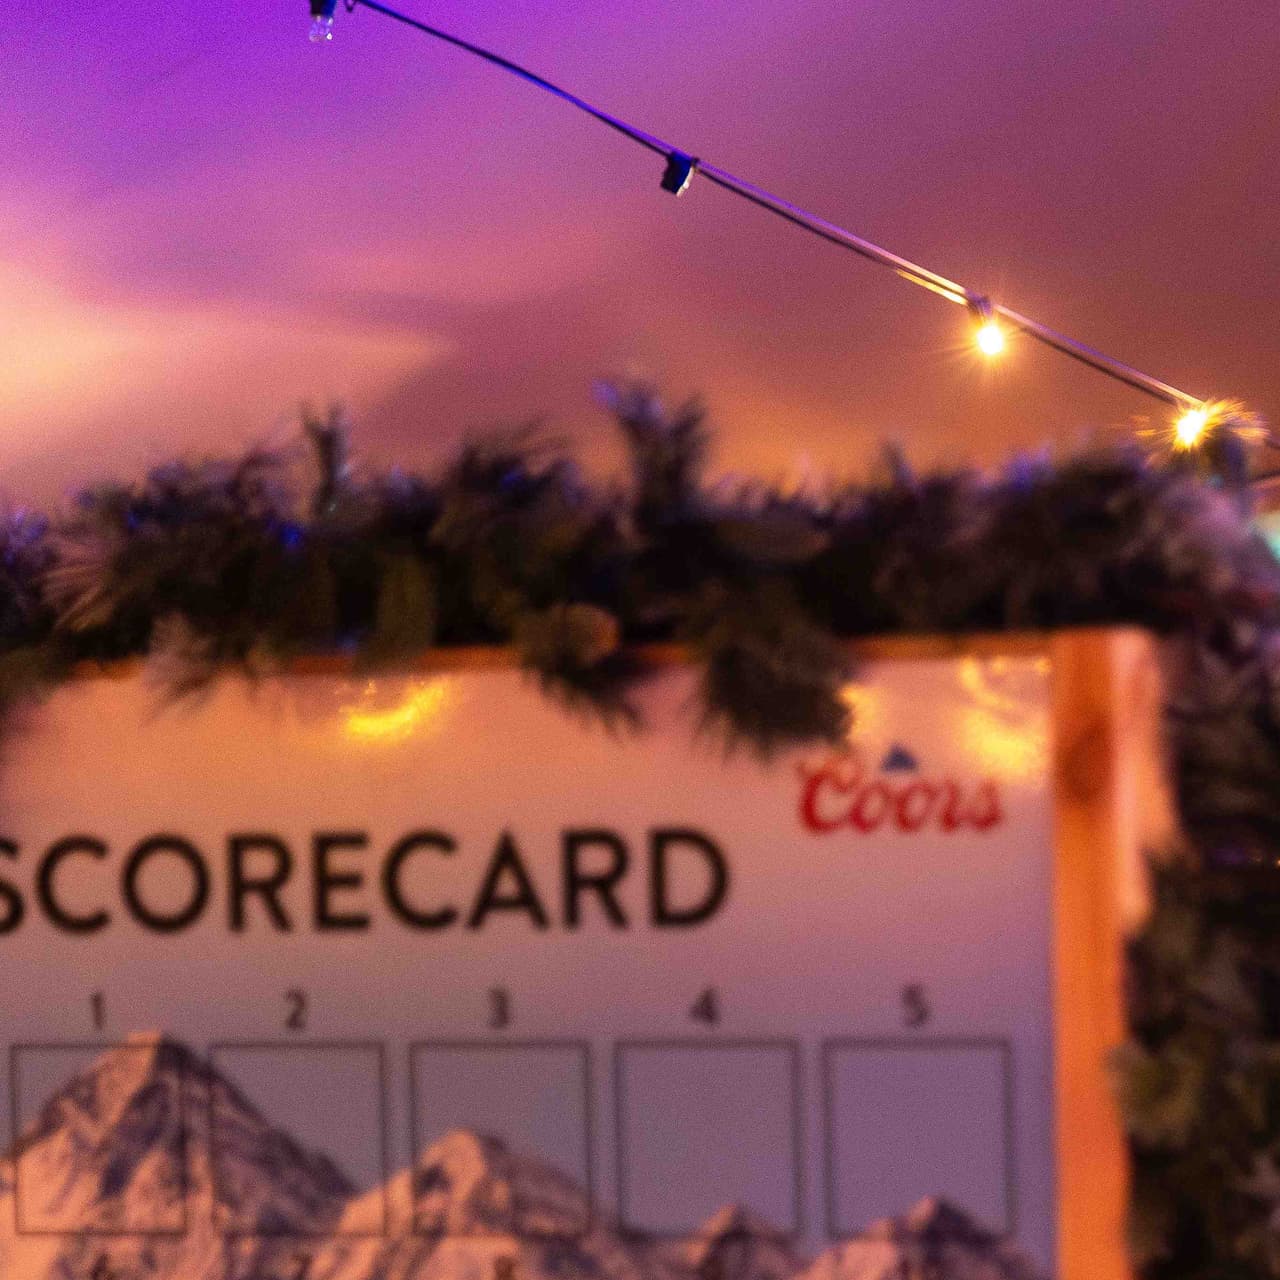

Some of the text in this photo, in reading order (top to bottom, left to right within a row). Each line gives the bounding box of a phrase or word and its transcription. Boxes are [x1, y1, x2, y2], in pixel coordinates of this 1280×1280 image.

[796, 752, 1004, 836] Coors
[89, 986, 930, 1031] 1 2 3 4 5
